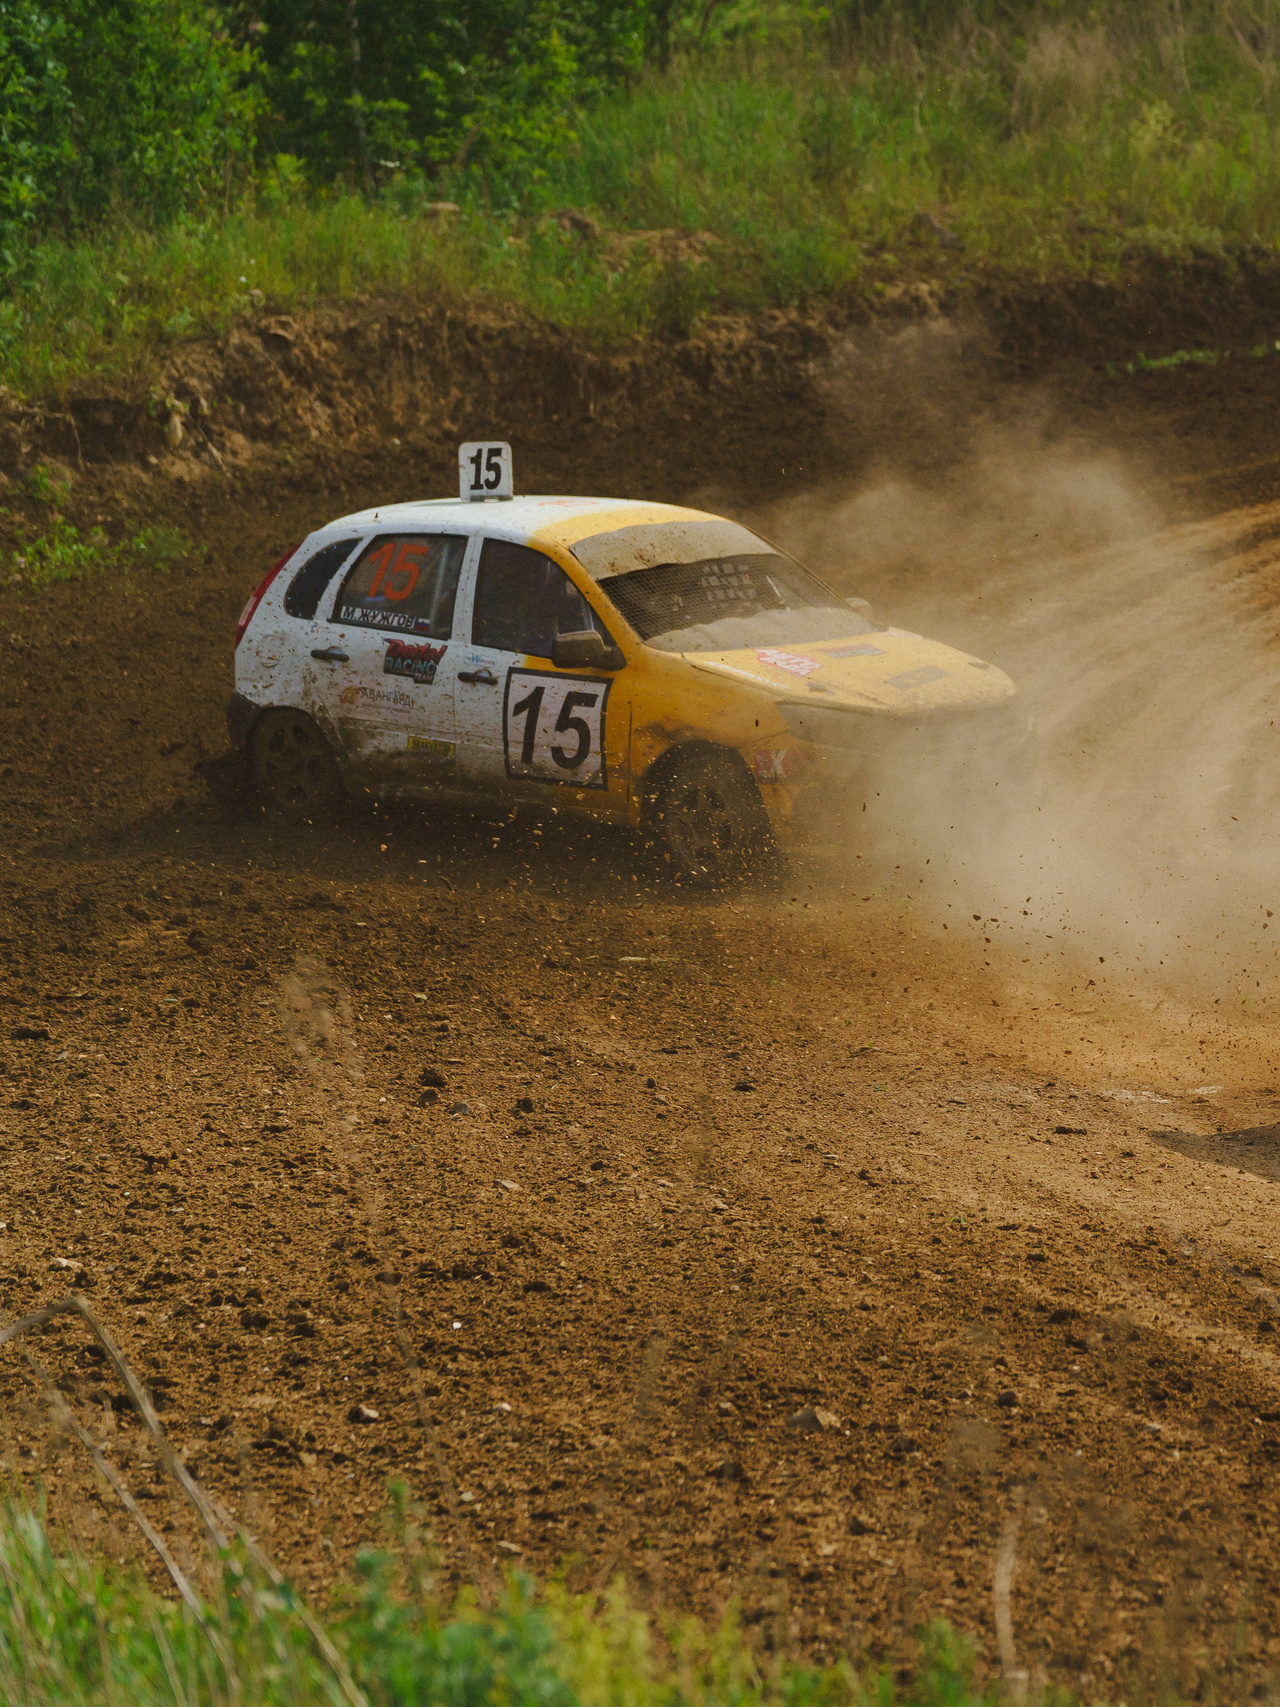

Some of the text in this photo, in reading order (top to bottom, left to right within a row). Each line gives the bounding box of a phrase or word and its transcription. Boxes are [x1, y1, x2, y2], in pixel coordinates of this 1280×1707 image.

[470, 448, 503, 490] 15
[369, 543, 429, 600] 15
[343, 608, 414, 629] М.ЖУЖГОВ
[513, 686, 599, 770] 15
